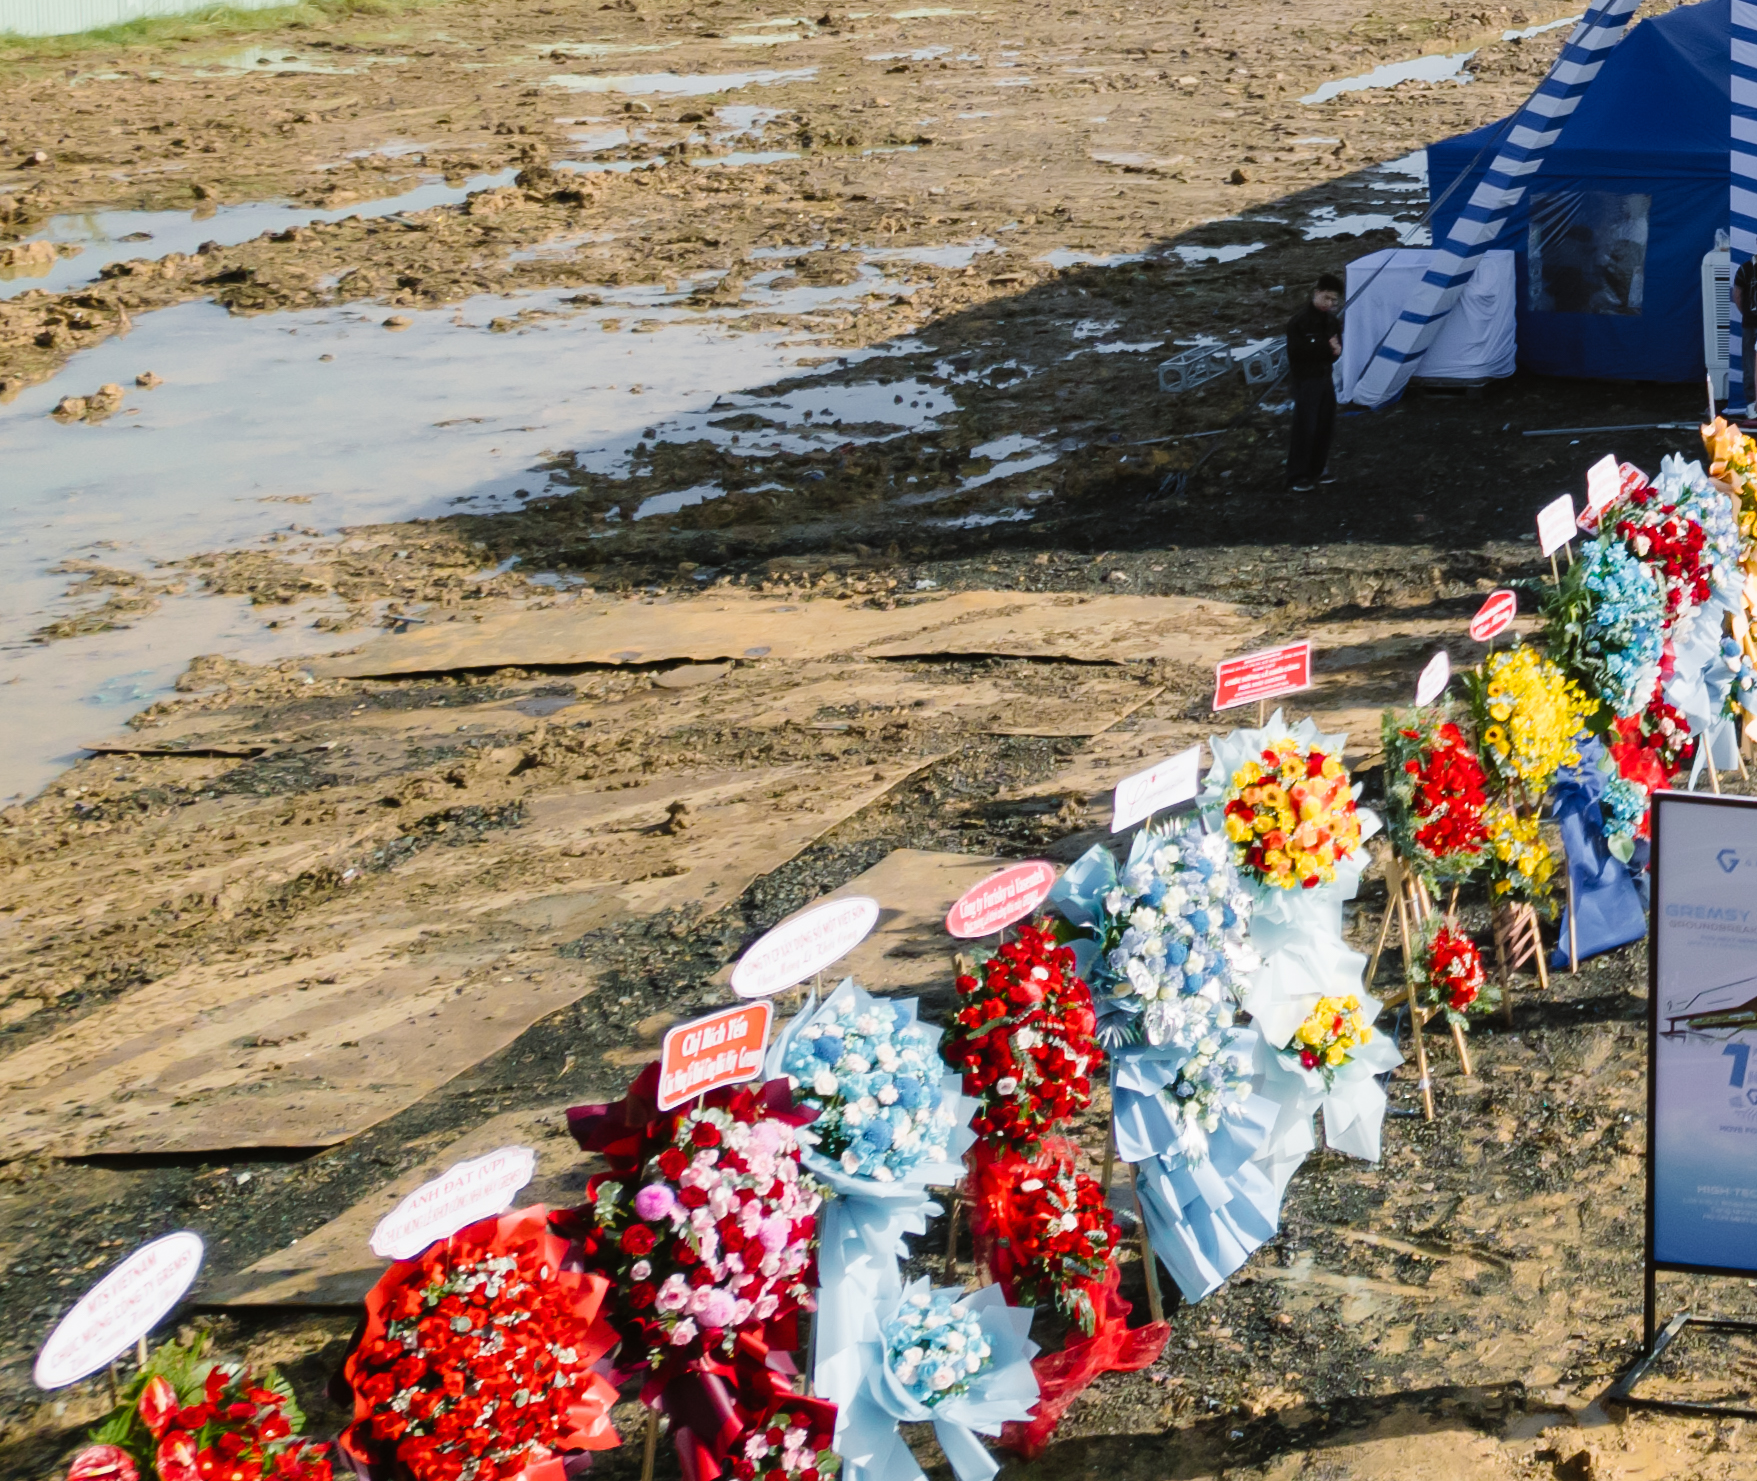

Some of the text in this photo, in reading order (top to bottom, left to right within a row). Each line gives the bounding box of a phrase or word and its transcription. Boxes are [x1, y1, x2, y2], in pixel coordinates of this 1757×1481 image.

[1664, 903, 1750, 923] GREMSY
[407, 1157, 505, 1213] ANH ĐẠT (VP)
[1697, 1184, 1730, 1196] HIGH
